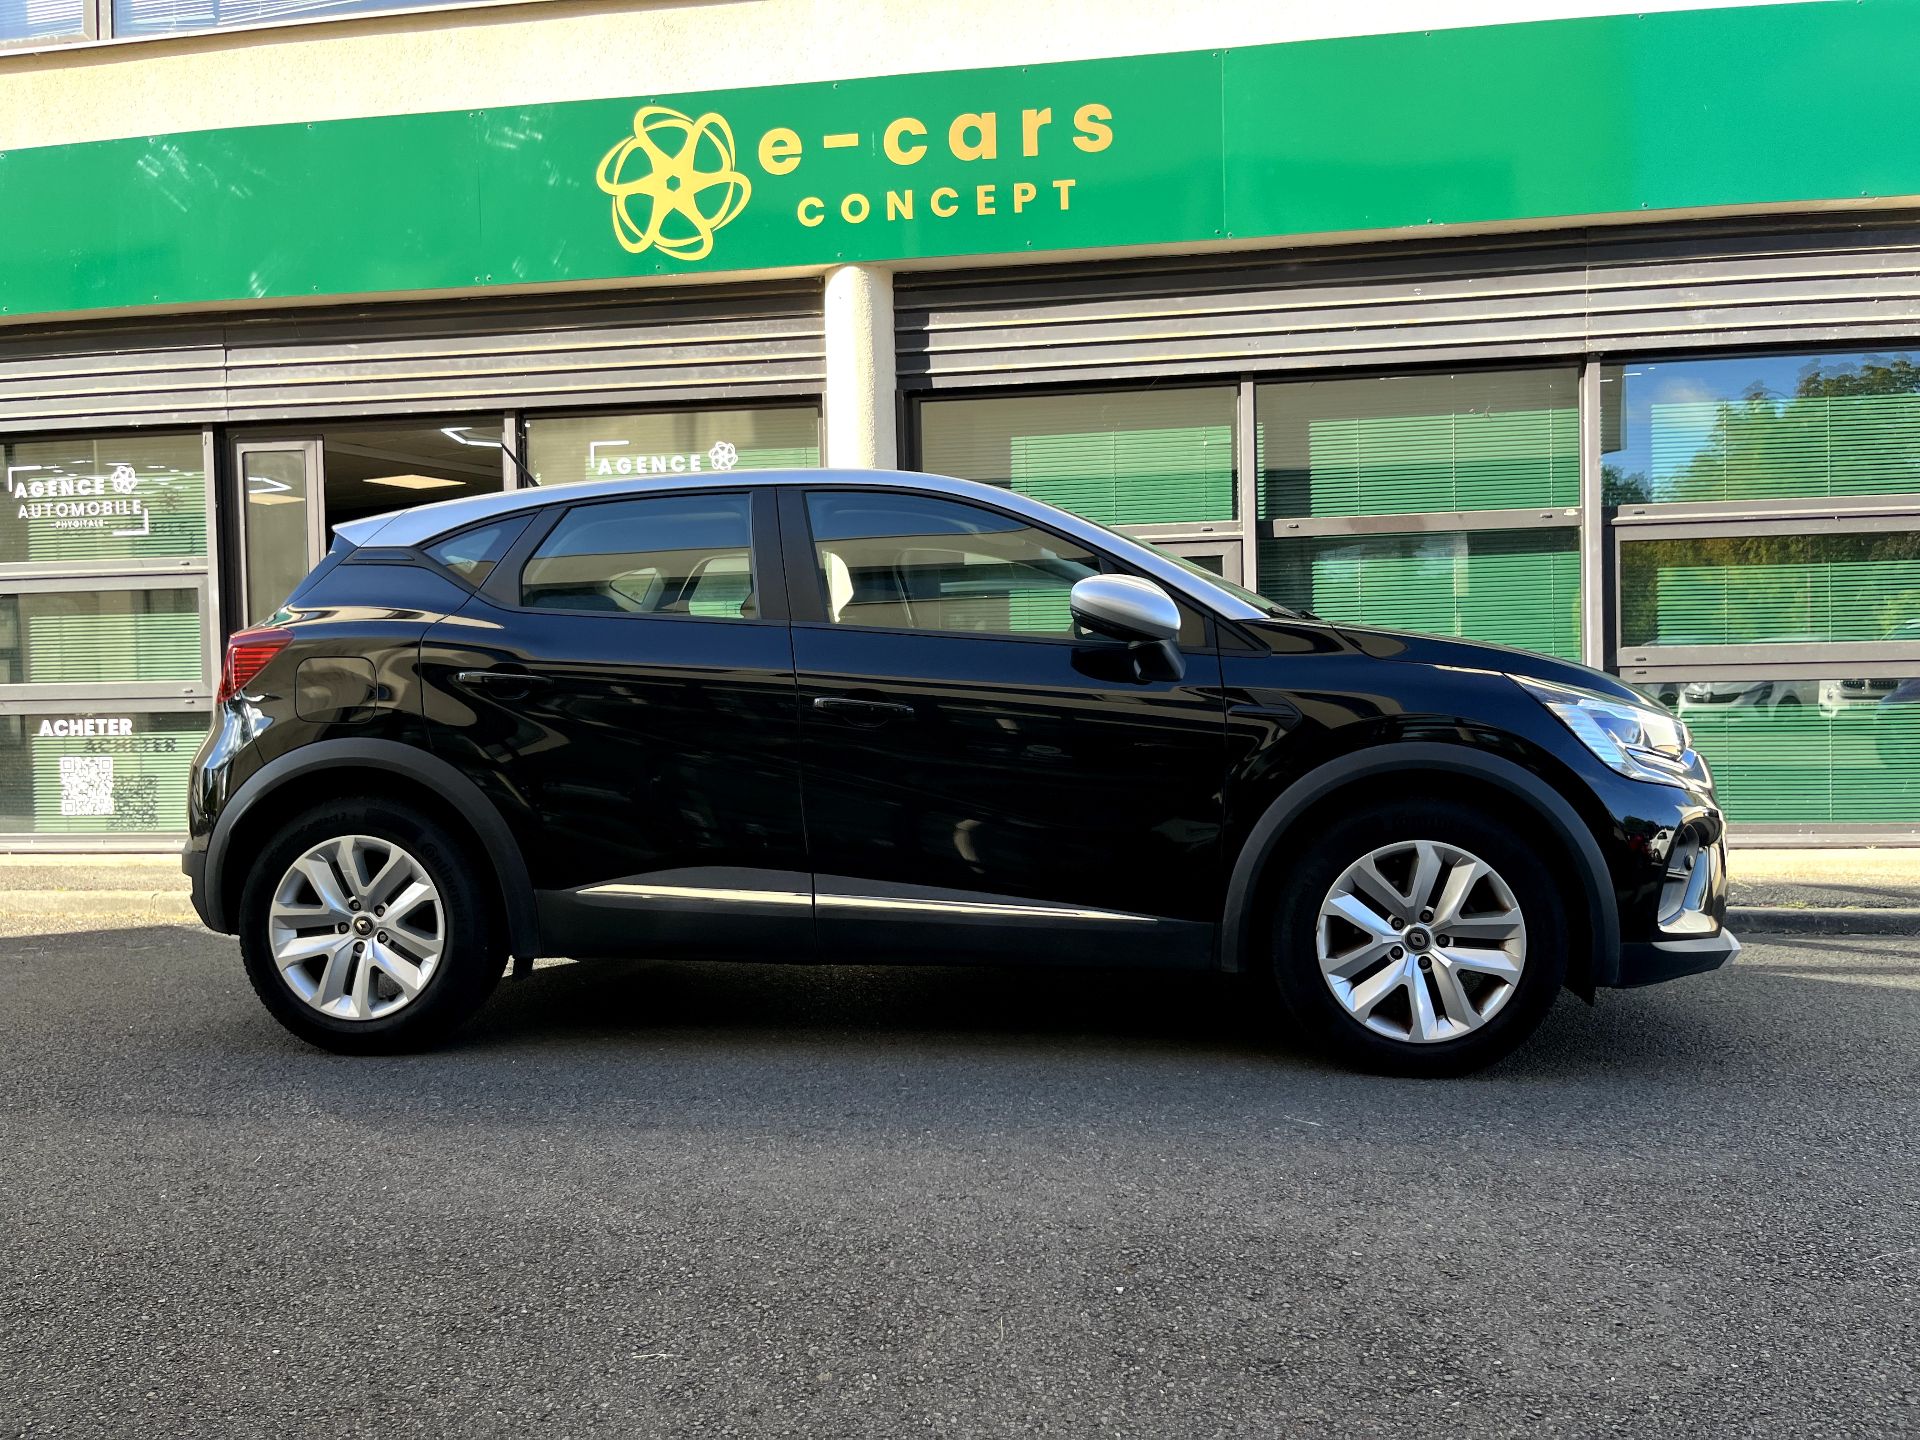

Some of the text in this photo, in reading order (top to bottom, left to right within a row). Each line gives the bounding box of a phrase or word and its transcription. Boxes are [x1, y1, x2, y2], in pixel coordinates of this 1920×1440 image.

[797, 178, 1077, 228] CONCEPT
[597, 454, 702, 476] AGENCE
[14, 478, 106, 499] AGENCE
[18, 499, 143, 519] AUTOMOBILE
[39, 717, 134, 737] ACHETER
